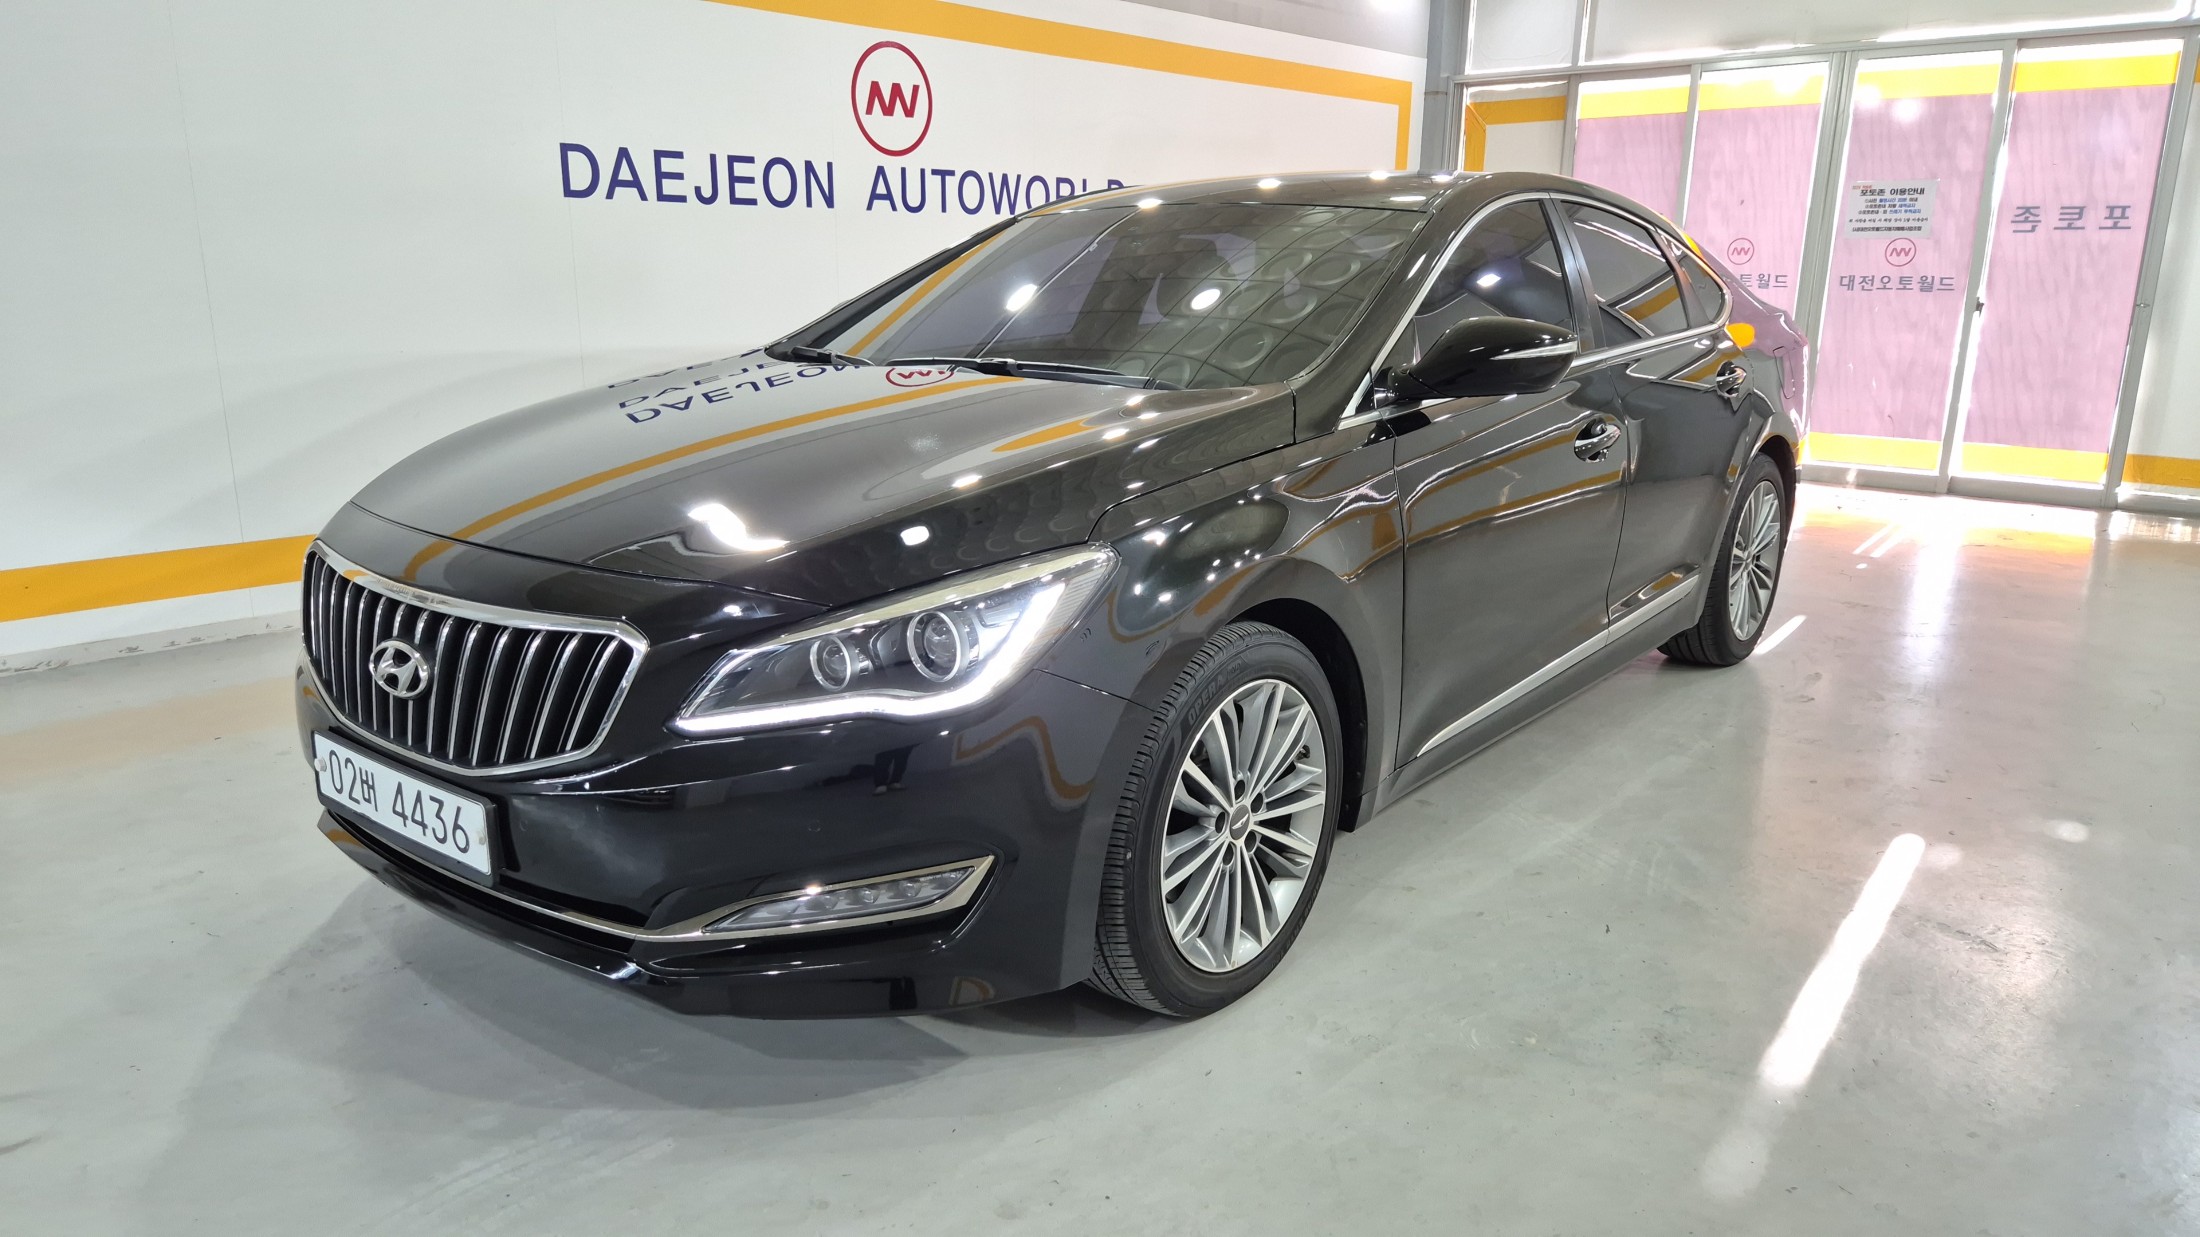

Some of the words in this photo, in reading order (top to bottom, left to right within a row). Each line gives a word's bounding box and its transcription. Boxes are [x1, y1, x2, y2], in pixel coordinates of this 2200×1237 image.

[559, 142, 834, 209] DAEJEON
[866, 165, 1125, 215] AUTOWOR
[1860, 188, 1886, 197] 포토존
[1890, 187, 1925, 196] 이용안내
[1839, 275, 1956, 293] 대전오토월드
[328, 750, 379, 812] 02버
[391, 781, 471, 854] 4436
